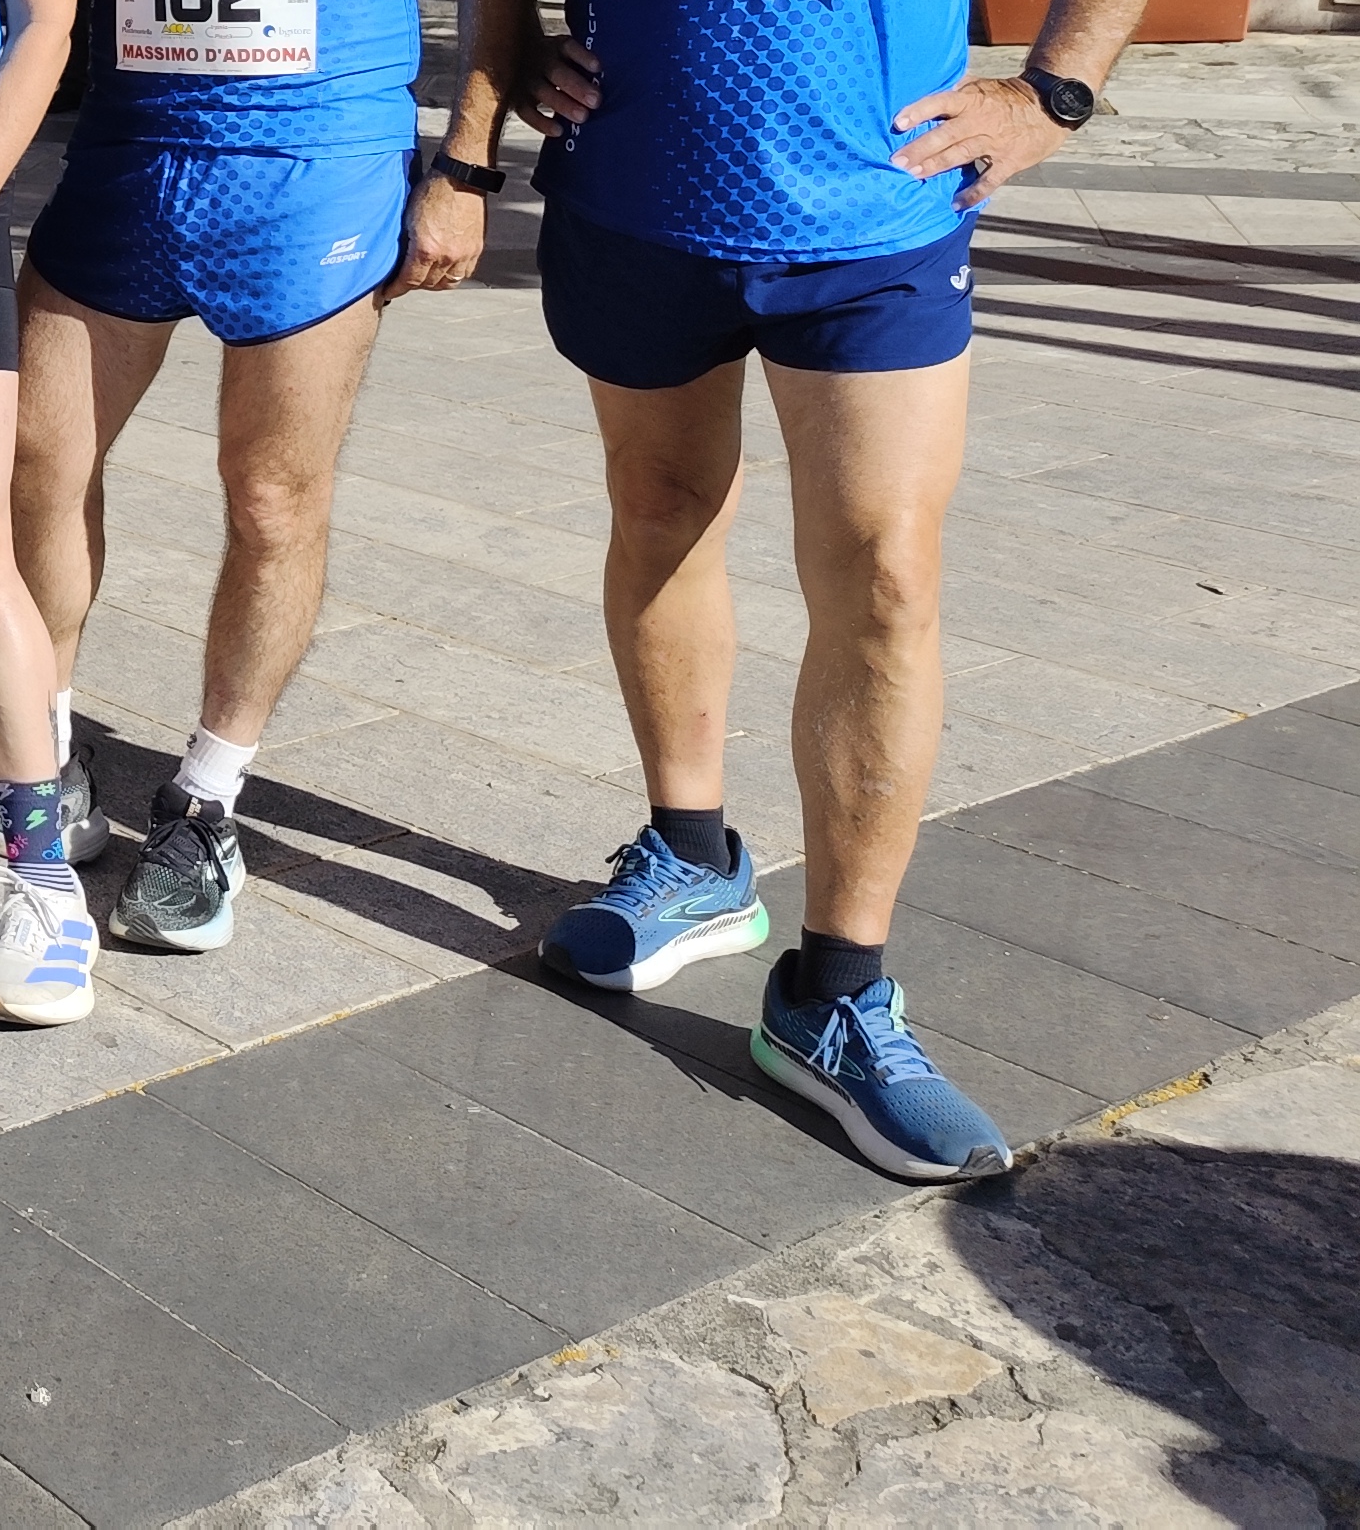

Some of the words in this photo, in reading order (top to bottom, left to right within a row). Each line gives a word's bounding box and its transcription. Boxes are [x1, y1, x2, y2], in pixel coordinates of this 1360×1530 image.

[161, 22, 194, 35] ACCA
[122, 44, 199, 63] MASSIMO
[205, 47, 311, 63] D'ADDONA
[320, 250, 368, 266] GIOSPORT
